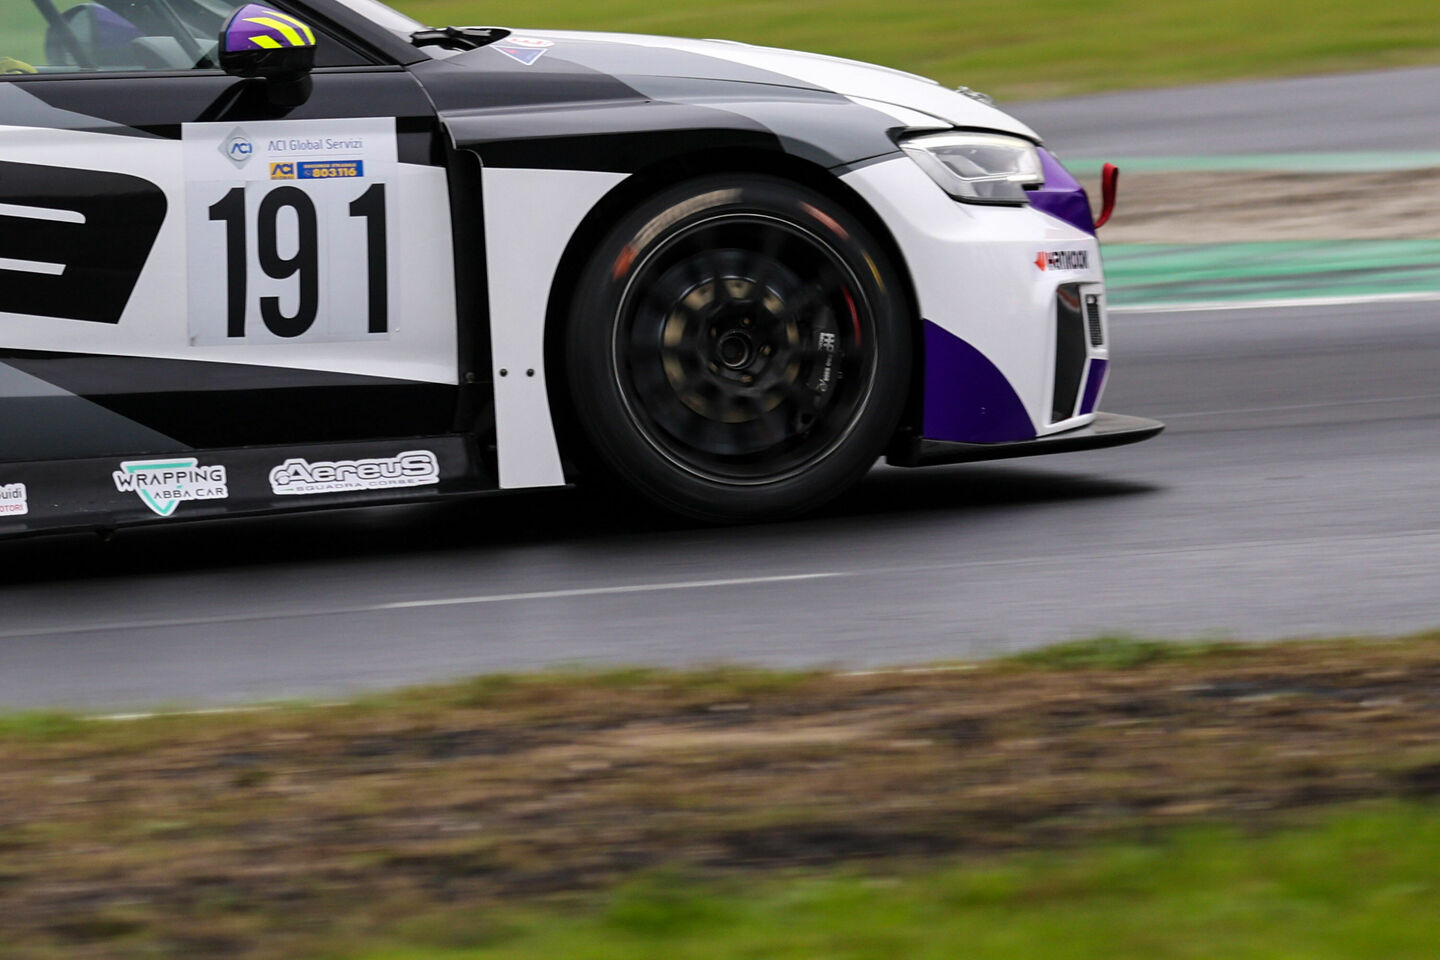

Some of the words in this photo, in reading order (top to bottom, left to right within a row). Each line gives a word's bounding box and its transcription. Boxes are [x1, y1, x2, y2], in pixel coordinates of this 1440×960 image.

[231, 142, 253, 154] ACI
[268, 140, 287, 152] ACI
[289, 138, 323, 151] Global
[326, 136, 363, 150] Servizi
[272, 163, 294, 176] ACI
[208, 183, 389, 339] 191
[117, 470, 222, 488] WRAPPING
[154, 490, 191, 499] ABBA
[195, 487, 224, 497] CAR
